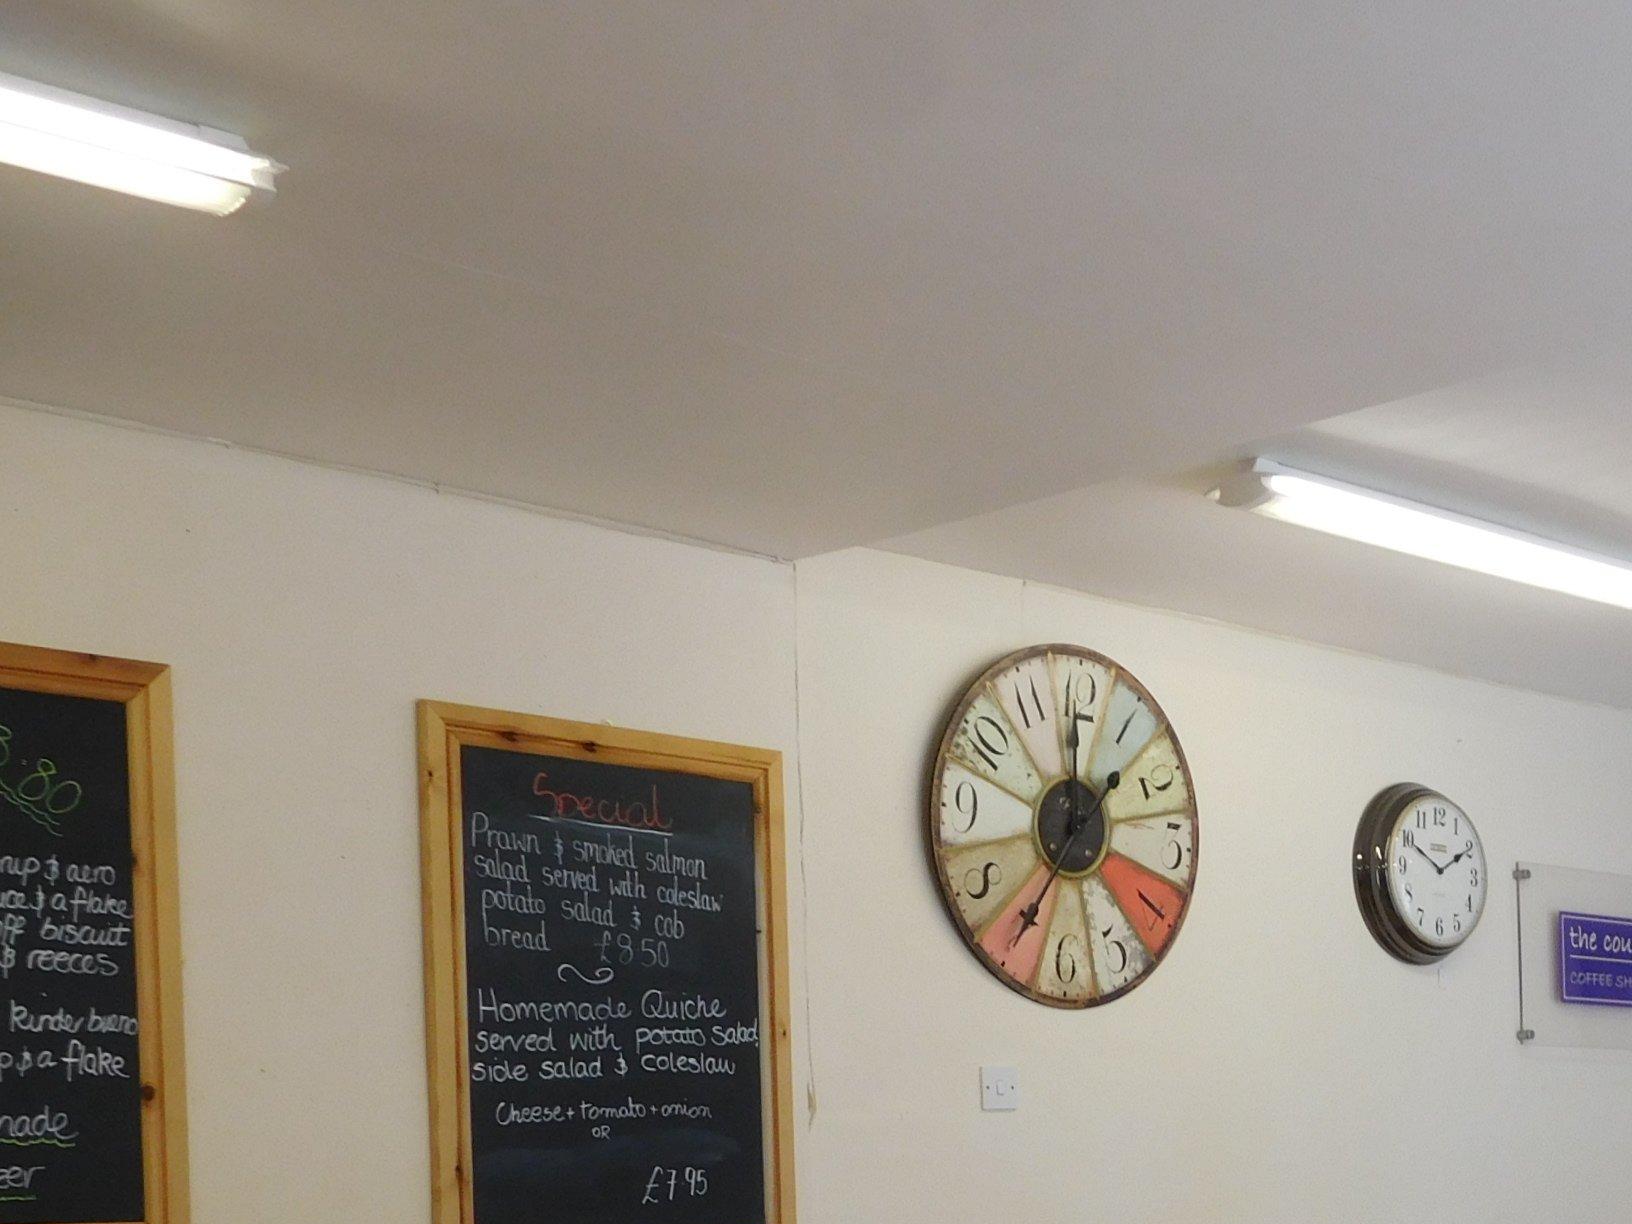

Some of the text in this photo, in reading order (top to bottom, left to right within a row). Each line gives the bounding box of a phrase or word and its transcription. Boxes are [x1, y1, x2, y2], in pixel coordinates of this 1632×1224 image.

[1013, 674, 1046, 729] 11
[1064, 672, 1097, 724] 12
[967, 715, 1009, 771] 10
[1115, 708, 1139, 745] 1
[1138, 763, 1174, 801] 2
[533, 772, 674, 828] Special
[951, 781, 978, 834] 9
[1432, 806, 1446, 827] 12
[1416, 810, 1427, 830] 11
[471, 811, 541, 854] Prawn
[572, 833, 638, 869] smoked
[646, 838, 708, 879] salmon
[1160, 822, 1183, 870] 3
[1402, 829, 1415, 848] 10
[1465, 840, 1473, 859] 2
[474, 849, 724, 912] salad served with coleslaw
[963, 861, 1002, 900] 8
[1399, 855, 1407, 875] 9
[1470, 868, 1478, 887] 3
[70, 885, 134, 922] flake
[482, 879, 546, 918] potato
[561, 891, 617, 927] salad
[654, 909, 685, 939] cob
[1137, 888, 1166, 932] 4
[1417, 907, 1425, 927] 7
[1465, 893, 1472, 913] 4
[40, 916, 131, 946] biscuit
[484, 920, 551, 951] bread
[1435, 917, 1444, 936] 6
[1454, 914, 1461, 932] 5
[1569, 925, 1598, 951] the
[1055, 933, 1080, 984] 6
[1101, 923, 1127, 975] 5
[1570, 970, 1614, 988] COFFEE
[478, 988, 727, 1022] Homemade Quiche
[474, 1028, 557, 1052] served
[570, 1023, 622, 1051] with
[635, 1026, 705, 1053] potato
[61, 1039, 130, 1082] flake
[472, 1057, 528, 1081] side
[539, 1057, 603, 1080] salad
[640, 1052, 736, 1075] coleslaw
[661, 1098, 713, 1118] onion
